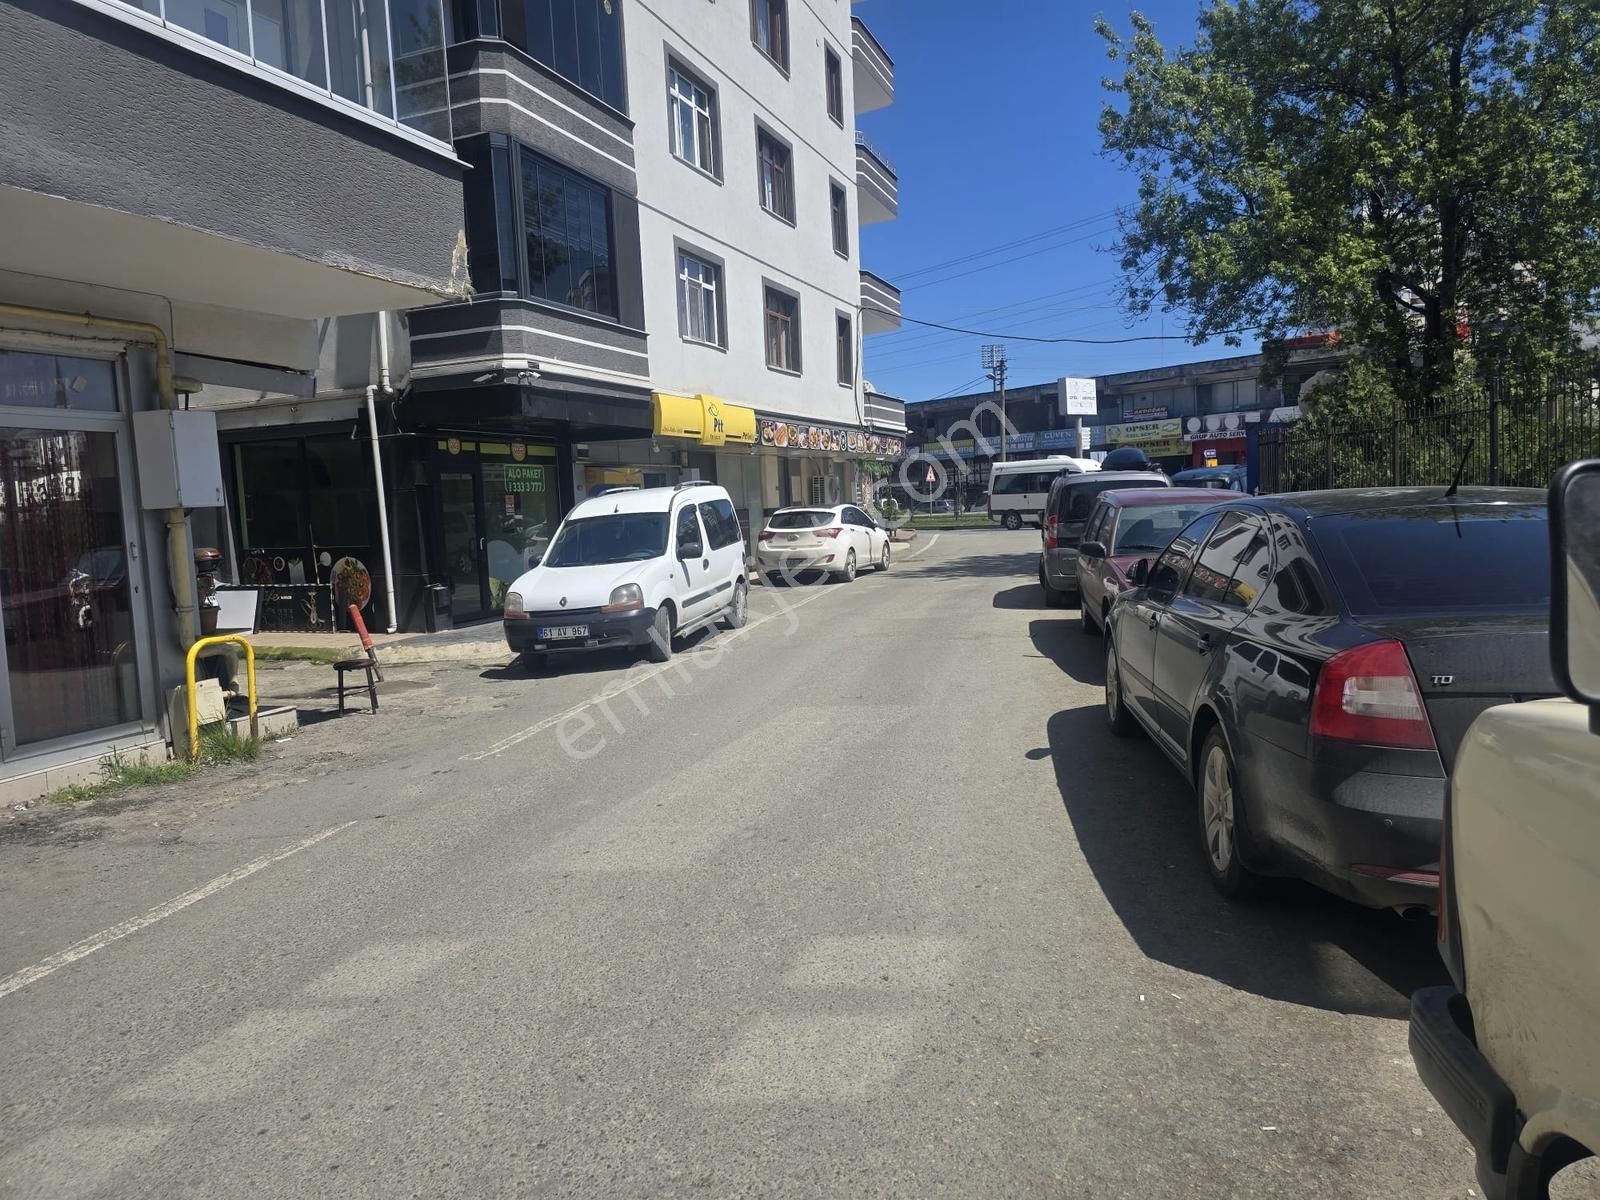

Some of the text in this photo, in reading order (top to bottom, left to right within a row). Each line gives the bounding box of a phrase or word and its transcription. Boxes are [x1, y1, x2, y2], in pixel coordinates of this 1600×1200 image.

[713, 416, 724, 433] Ptt
[1190, 433, 1208, 441] GRUP
[508, 468, 541, 479] ALO PAKET
[543, 626, 587, 638] 61 AV 967
